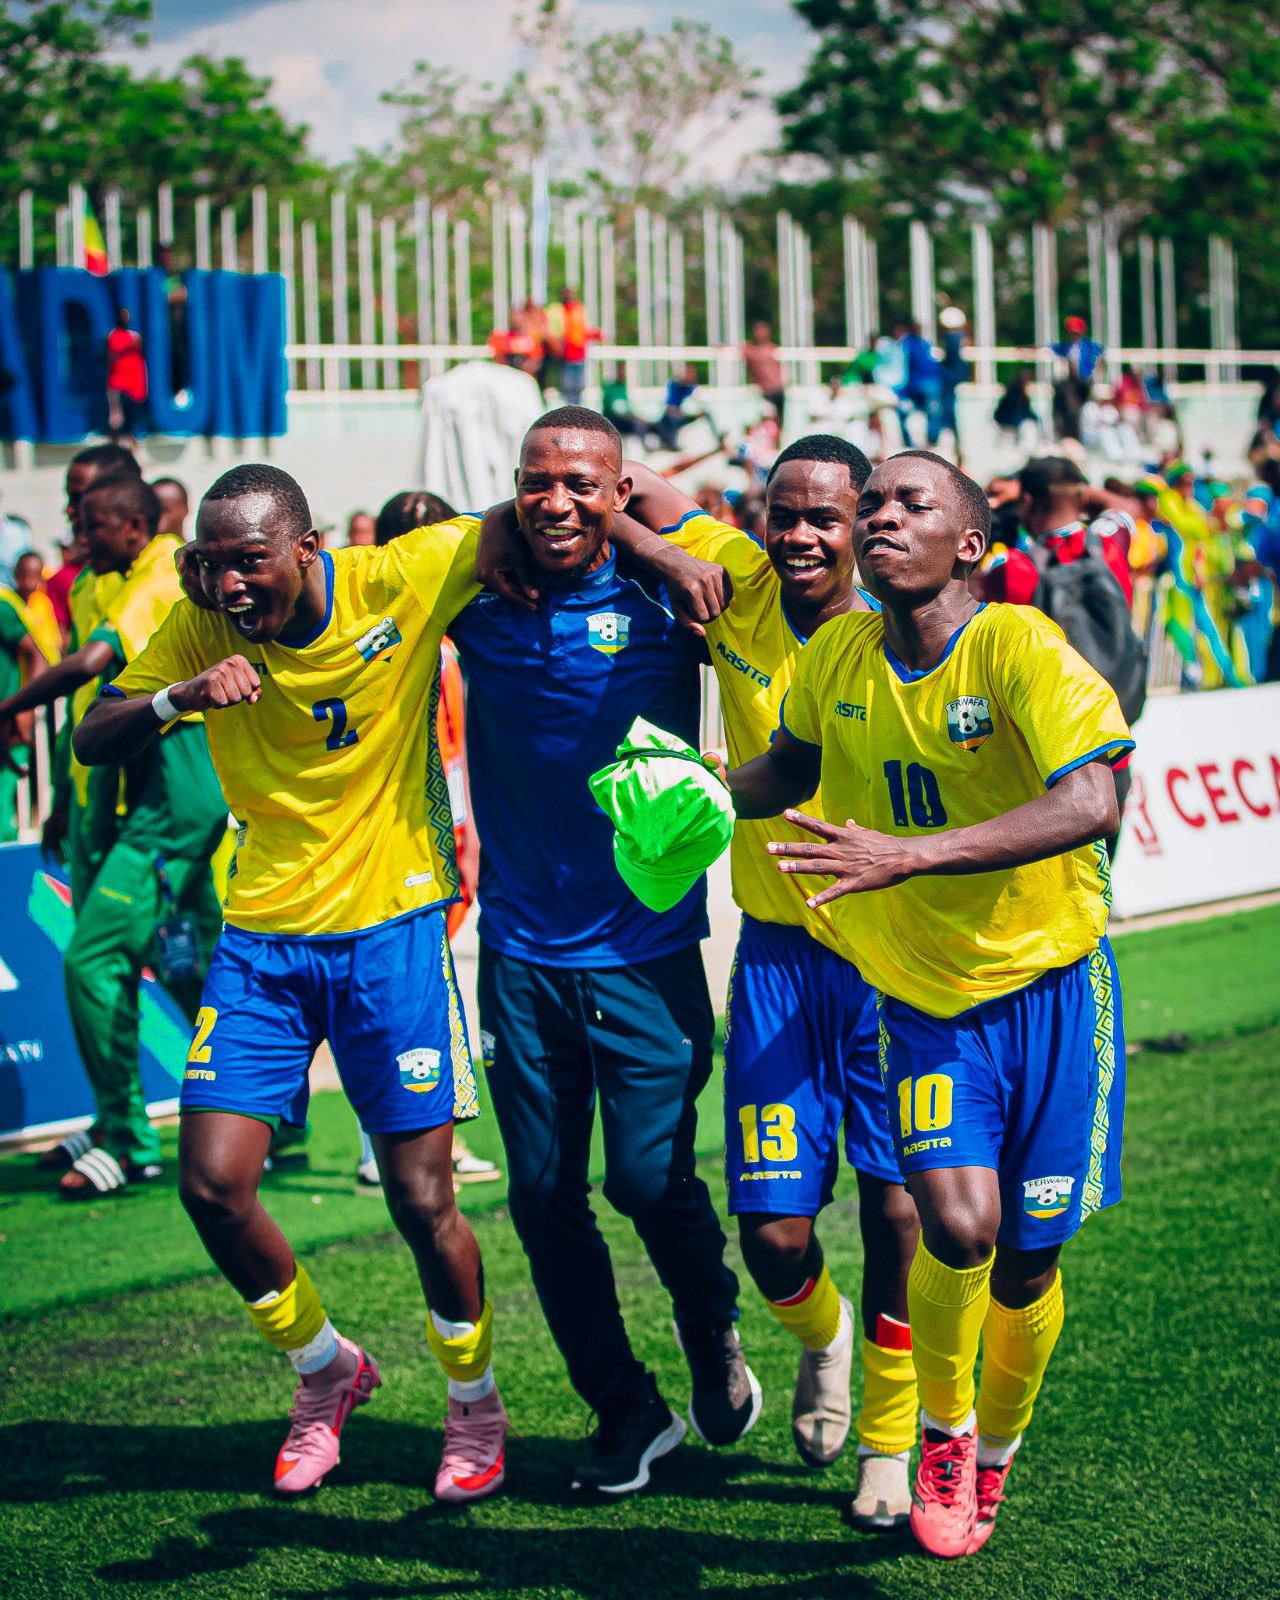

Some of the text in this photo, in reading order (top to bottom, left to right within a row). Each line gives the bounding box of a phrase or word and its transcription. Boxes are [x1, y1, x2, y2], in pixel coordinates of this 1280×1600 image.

[312, 697, 359, 751] 2
[883, 759, 948, 828] 10
[1165, 753, 1280, 829] CEC
[188, 1006, 219, 1064] 2
[738, 1102, 798, 1164] 13
[897, 1073, 954, 1139] 10
